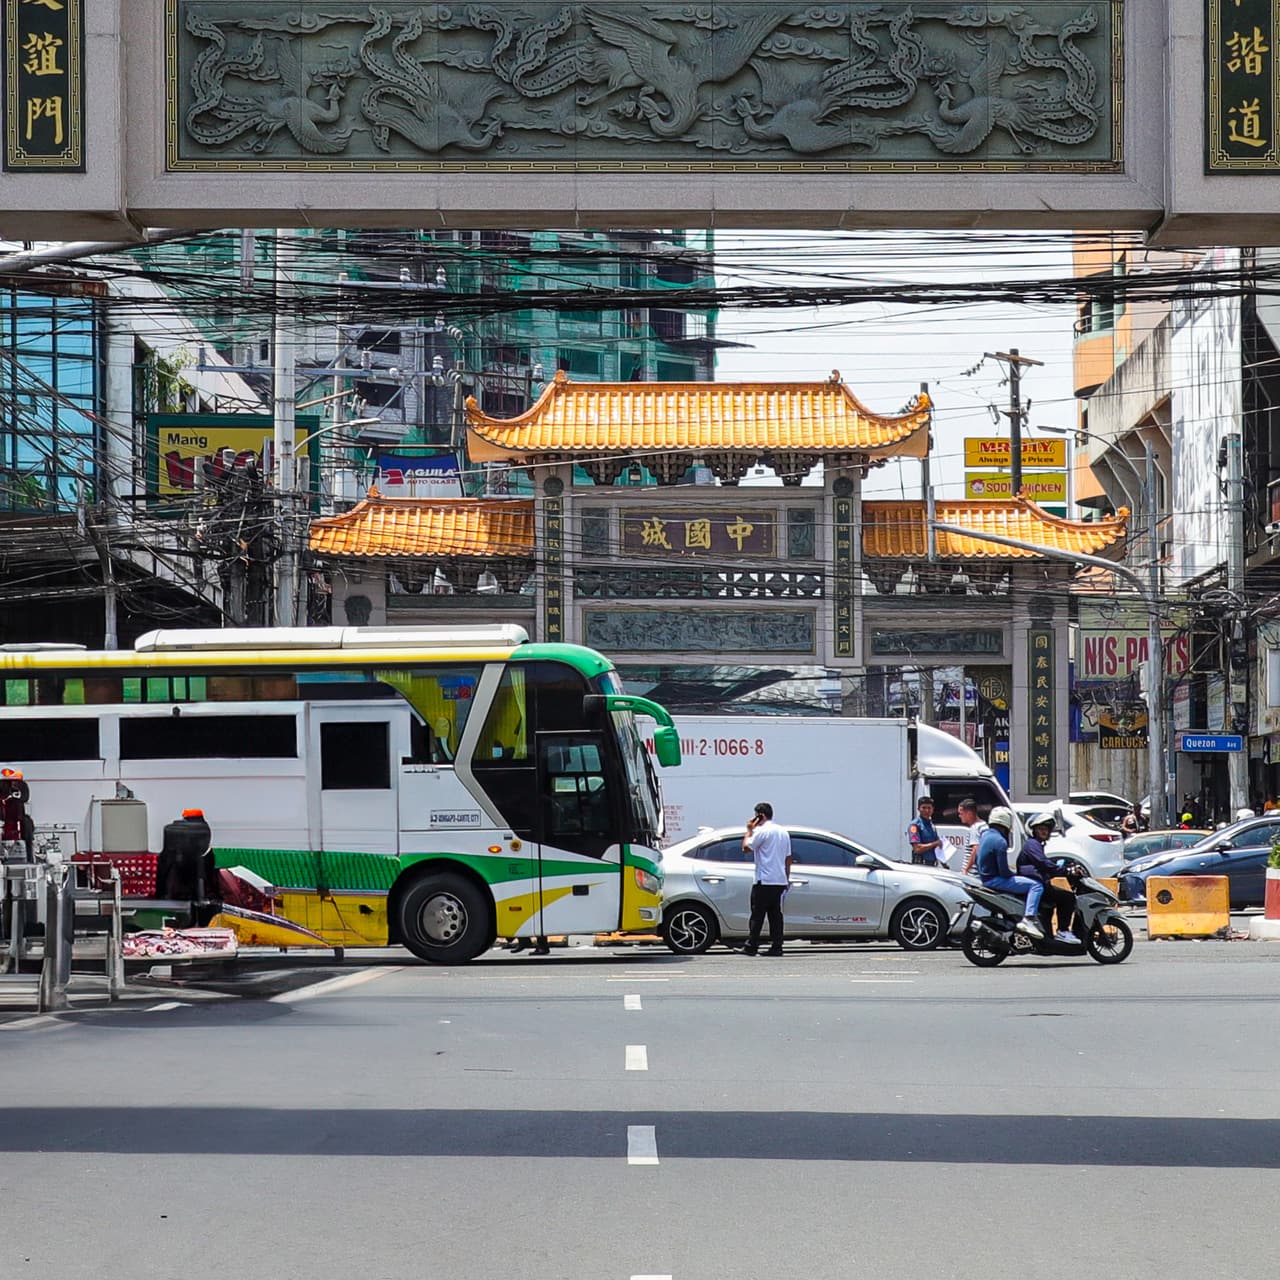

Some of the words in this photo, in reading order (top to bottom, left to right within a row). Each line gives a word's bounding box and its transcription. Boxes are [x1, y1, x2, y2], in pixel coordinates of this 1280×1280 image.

[167, 433, 208, 448] Mang
[405, 468, 455, 477] AGUILA
[1186, 738, 1216, 748] Quezon
